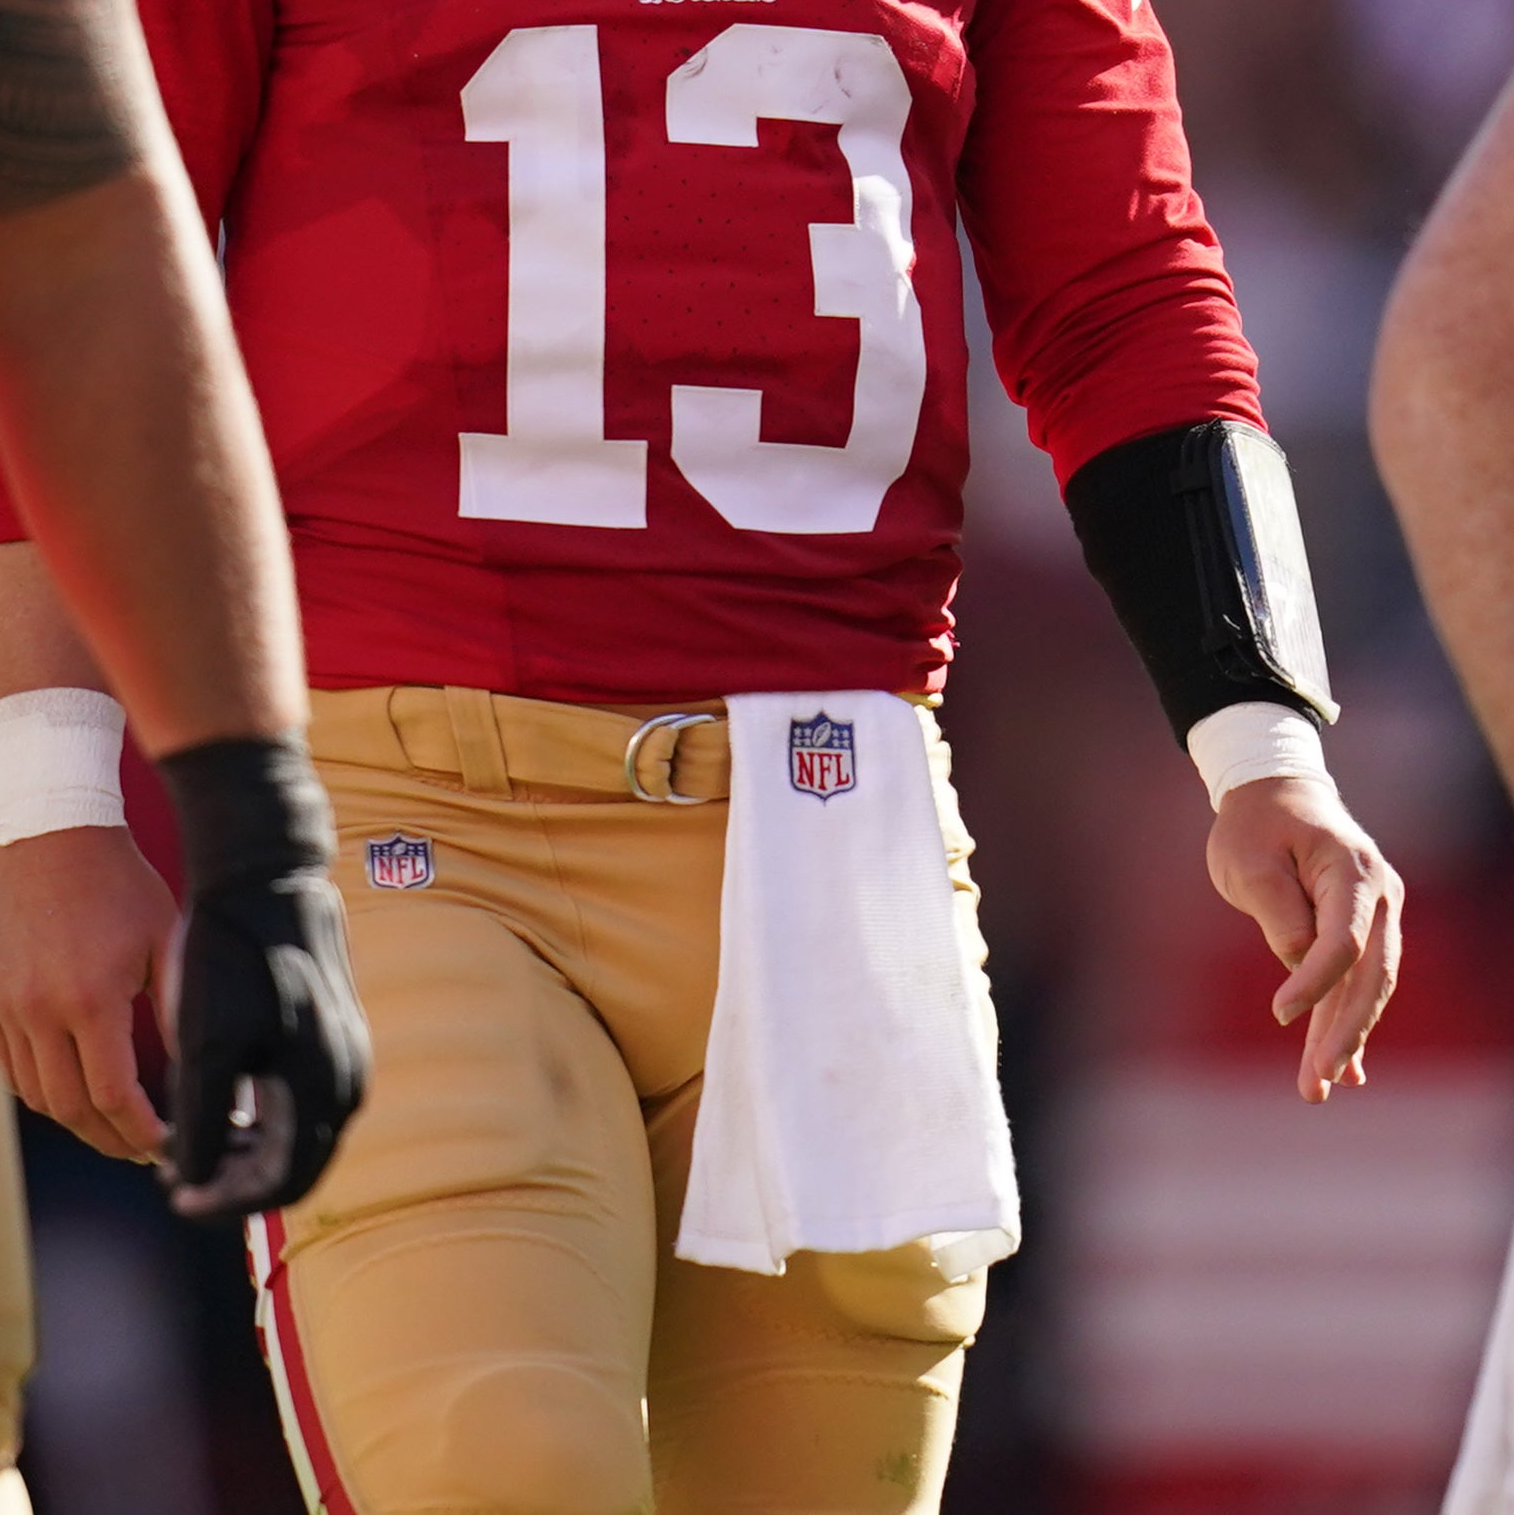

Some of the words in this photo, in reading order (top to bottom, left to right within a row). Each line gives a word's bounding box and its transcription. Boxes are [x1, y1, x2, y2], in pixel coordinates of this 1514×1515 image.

[457, 23, 926, 534] 13
[796, 751, 851, 790] NFL
[377, 856, 425, 884] NFL
